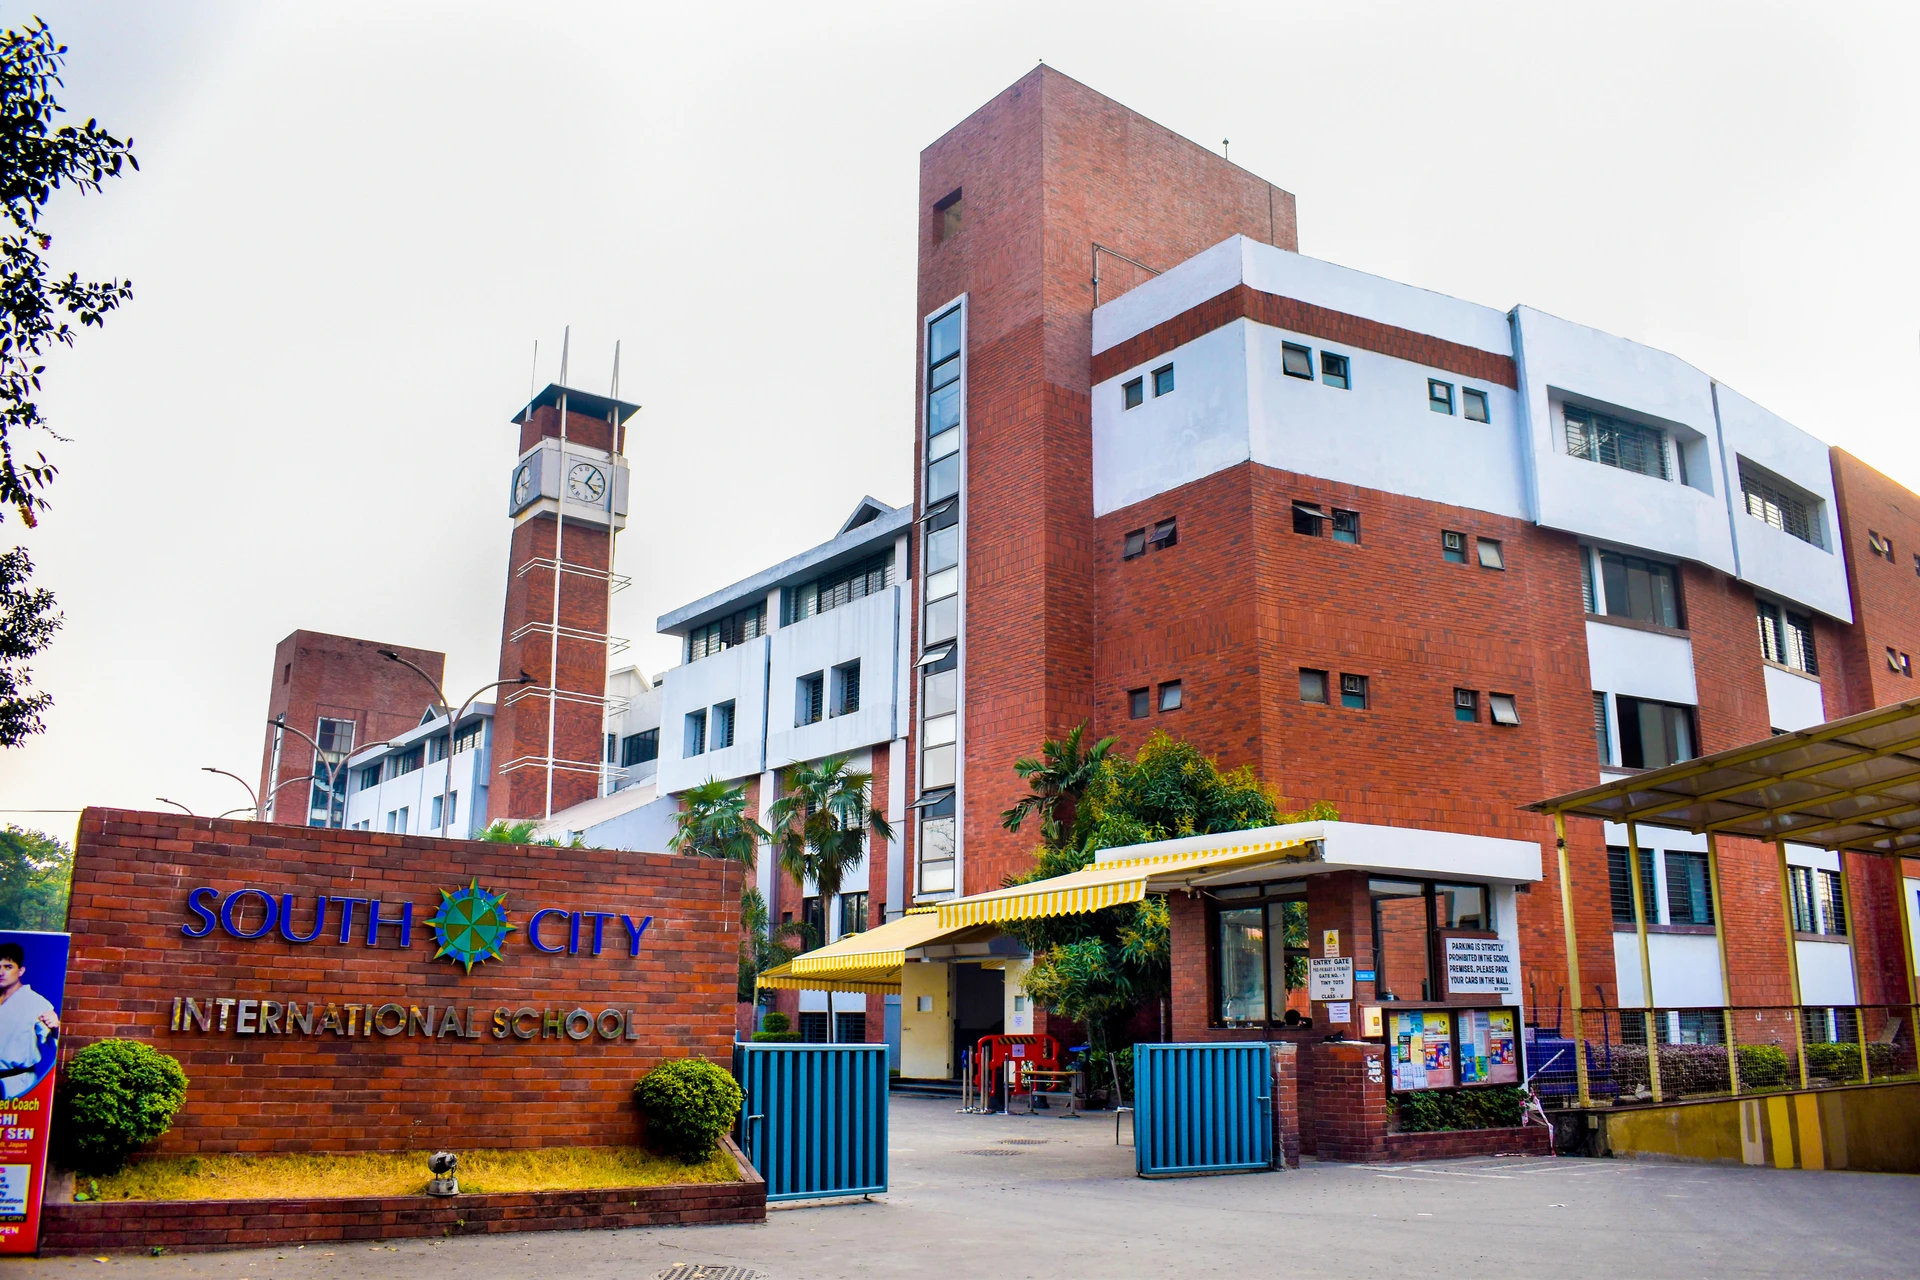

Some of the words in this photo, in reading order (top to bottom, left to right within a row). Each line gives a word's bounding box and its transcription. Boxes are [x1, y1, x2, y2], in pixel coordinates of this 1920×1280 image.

[181, 886, 413, 947] SOUTH
[528, 907, 654, 957] CITY
[1451, 942, 1474, 951] PARKING
[1474, 943, 1481, 951] IS
[1481, 943, 1504, 951] STRICTLY
[1448, 953, 1477, 962] PROHIBITED
[1478, 954, 1483, 962] IN
[1483, 954, 1493, 962] THE
[1493, 954, 1510, 963] SCHOOL
[1449, 964, 1476, 973] PREMISES.
[1476, 965, 1495, 973] PLEASE
[1495, 966, 1508, 974] PARK
[1450, 976, 1464, 984] YOUR
[1465, 976, 1478, 985] CARS
[1479, 976, 1484, 985] IN
[1485, 976, 1495, 985] THE
[171, 996, 481, 1038] INTERNATIONAL
[493, 1005, 640, 1040] SCHOOL
[12, 1097, 40, 1111] Coach
[7, 1127, 35, 1140] SEN
